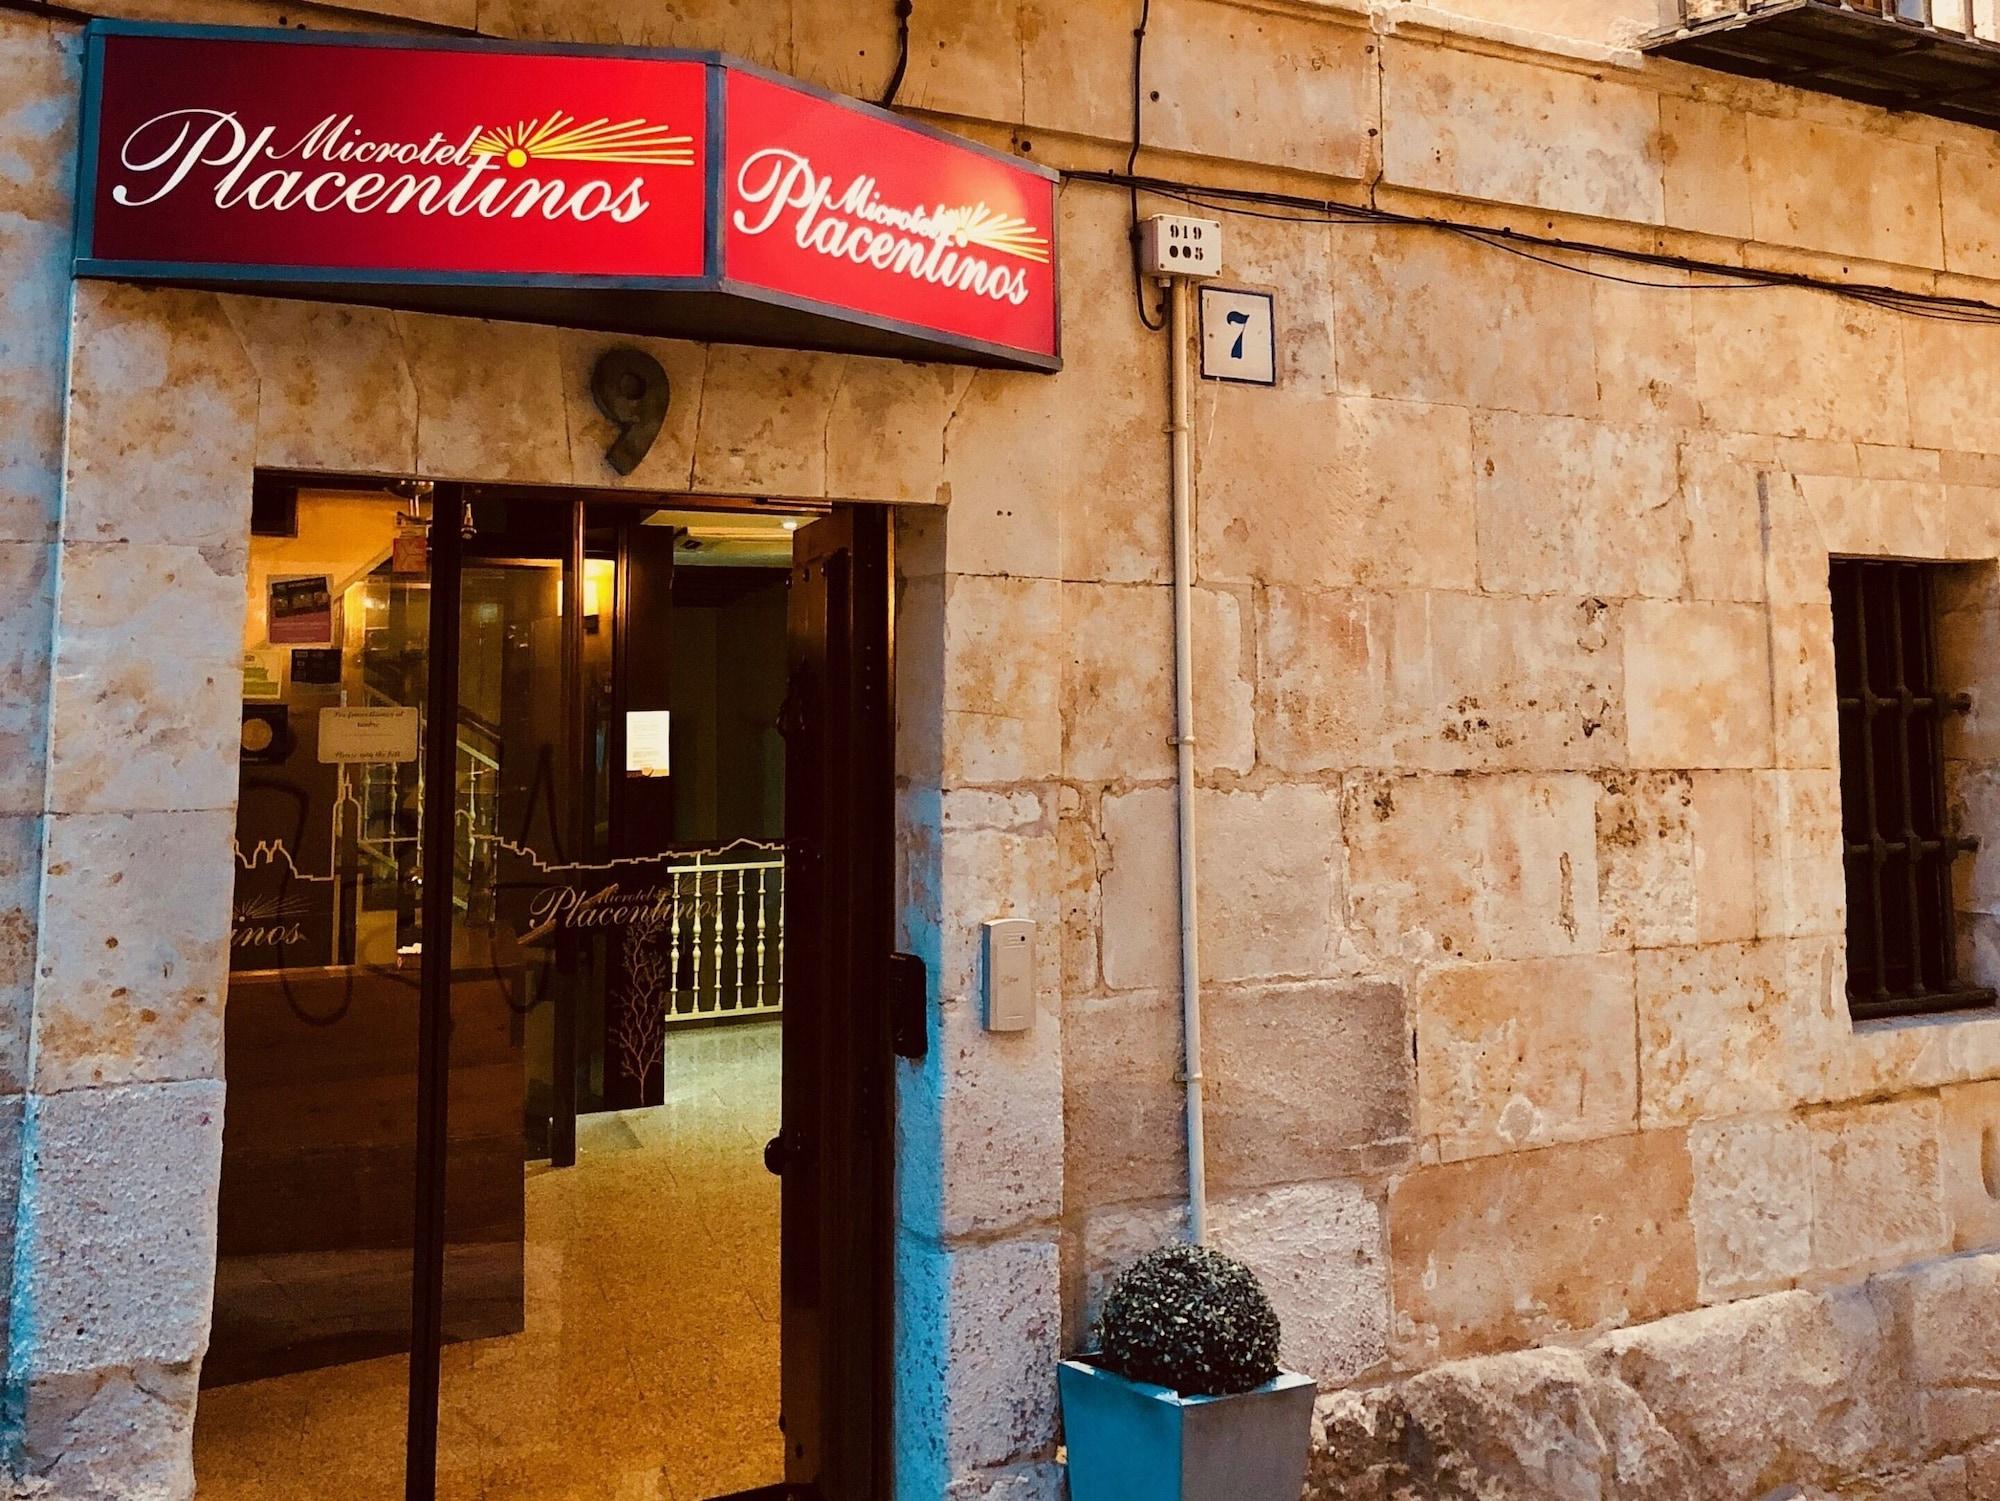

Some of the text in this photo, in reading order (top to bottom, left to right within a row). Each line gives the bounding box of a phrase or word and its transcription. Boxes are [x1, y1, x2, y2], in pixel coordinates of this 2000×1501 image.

[112, 108, 650, 223] Placentinos
[266, 113, 483, 167] Microtel
[733, 148, 1029, 305] Placentinos
[826, 174, 947, 240] Microtel
[1170, 224, 1202, 240] 919
[1226, 310, 1250, 360] 7
[590, 347, 671, 477] 9
